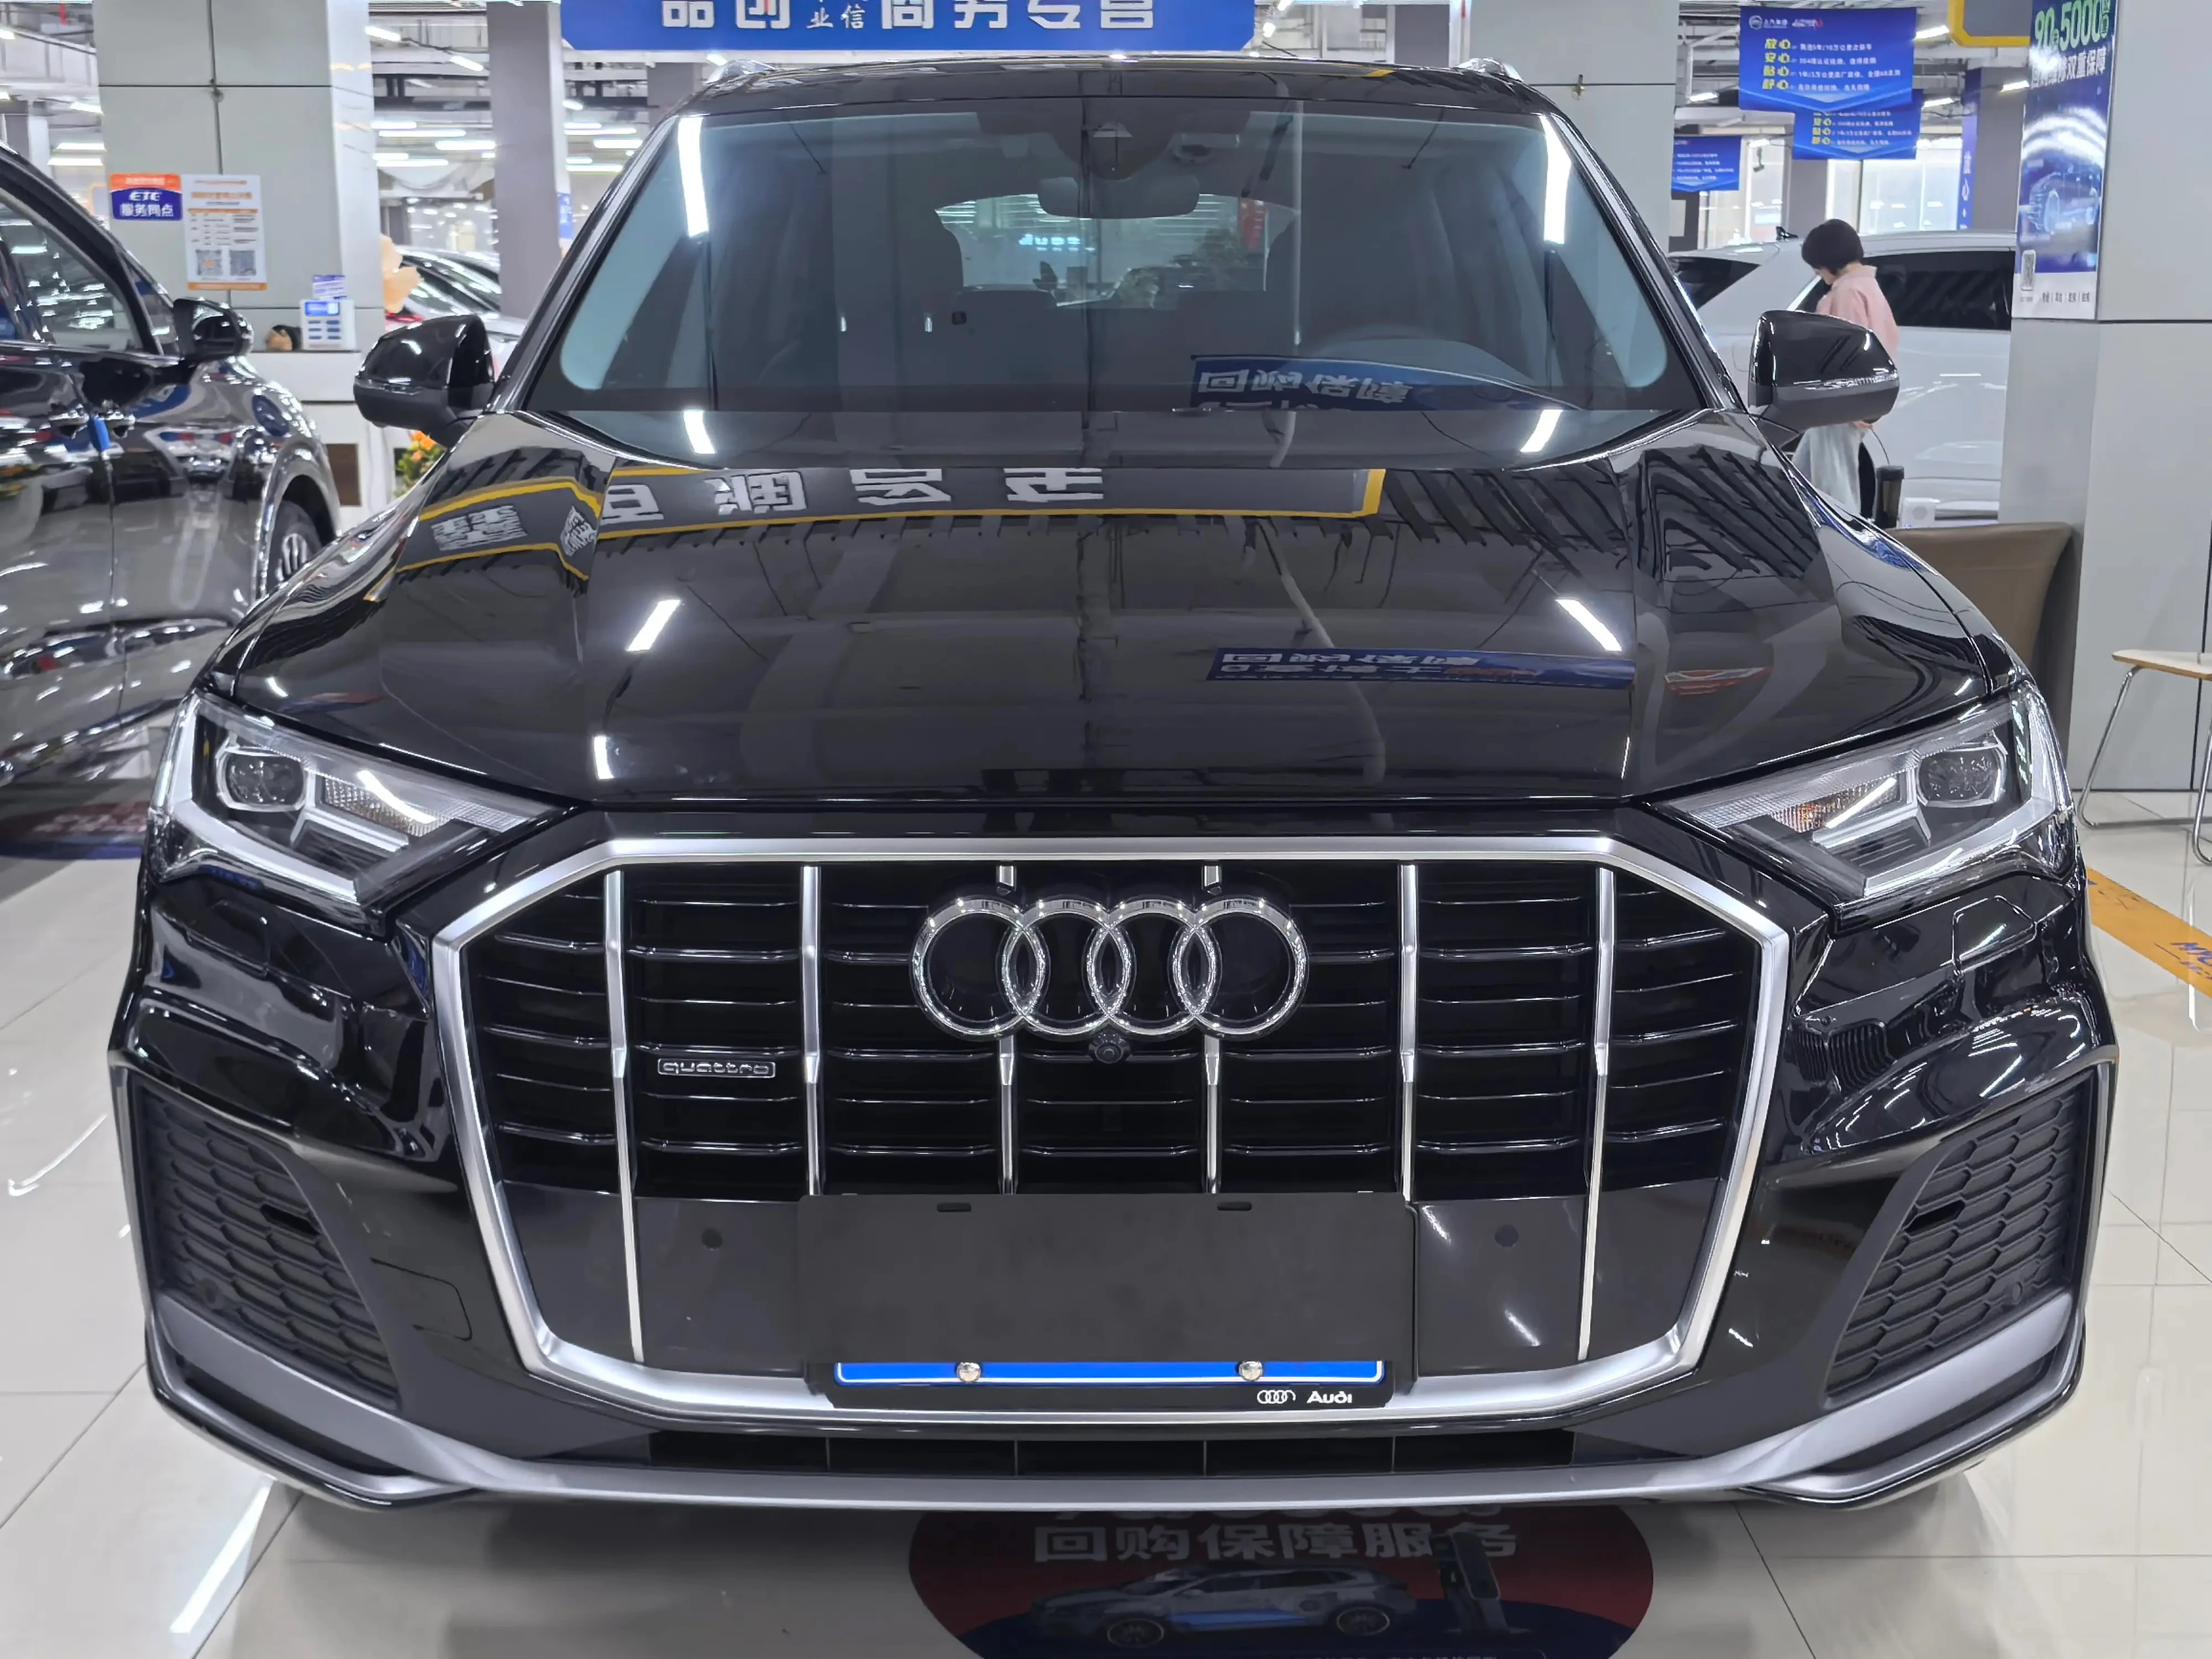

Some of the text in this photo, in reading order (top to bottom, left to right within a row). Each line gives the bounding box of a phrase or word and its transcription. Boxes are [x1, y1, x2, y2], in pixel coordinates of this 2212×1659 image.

[663, 1062, 769, 1074] quattro
[1306, 1391, 1353, 1404] Audi
[1035, 1522, 1517, 1562] 回购保障服务
